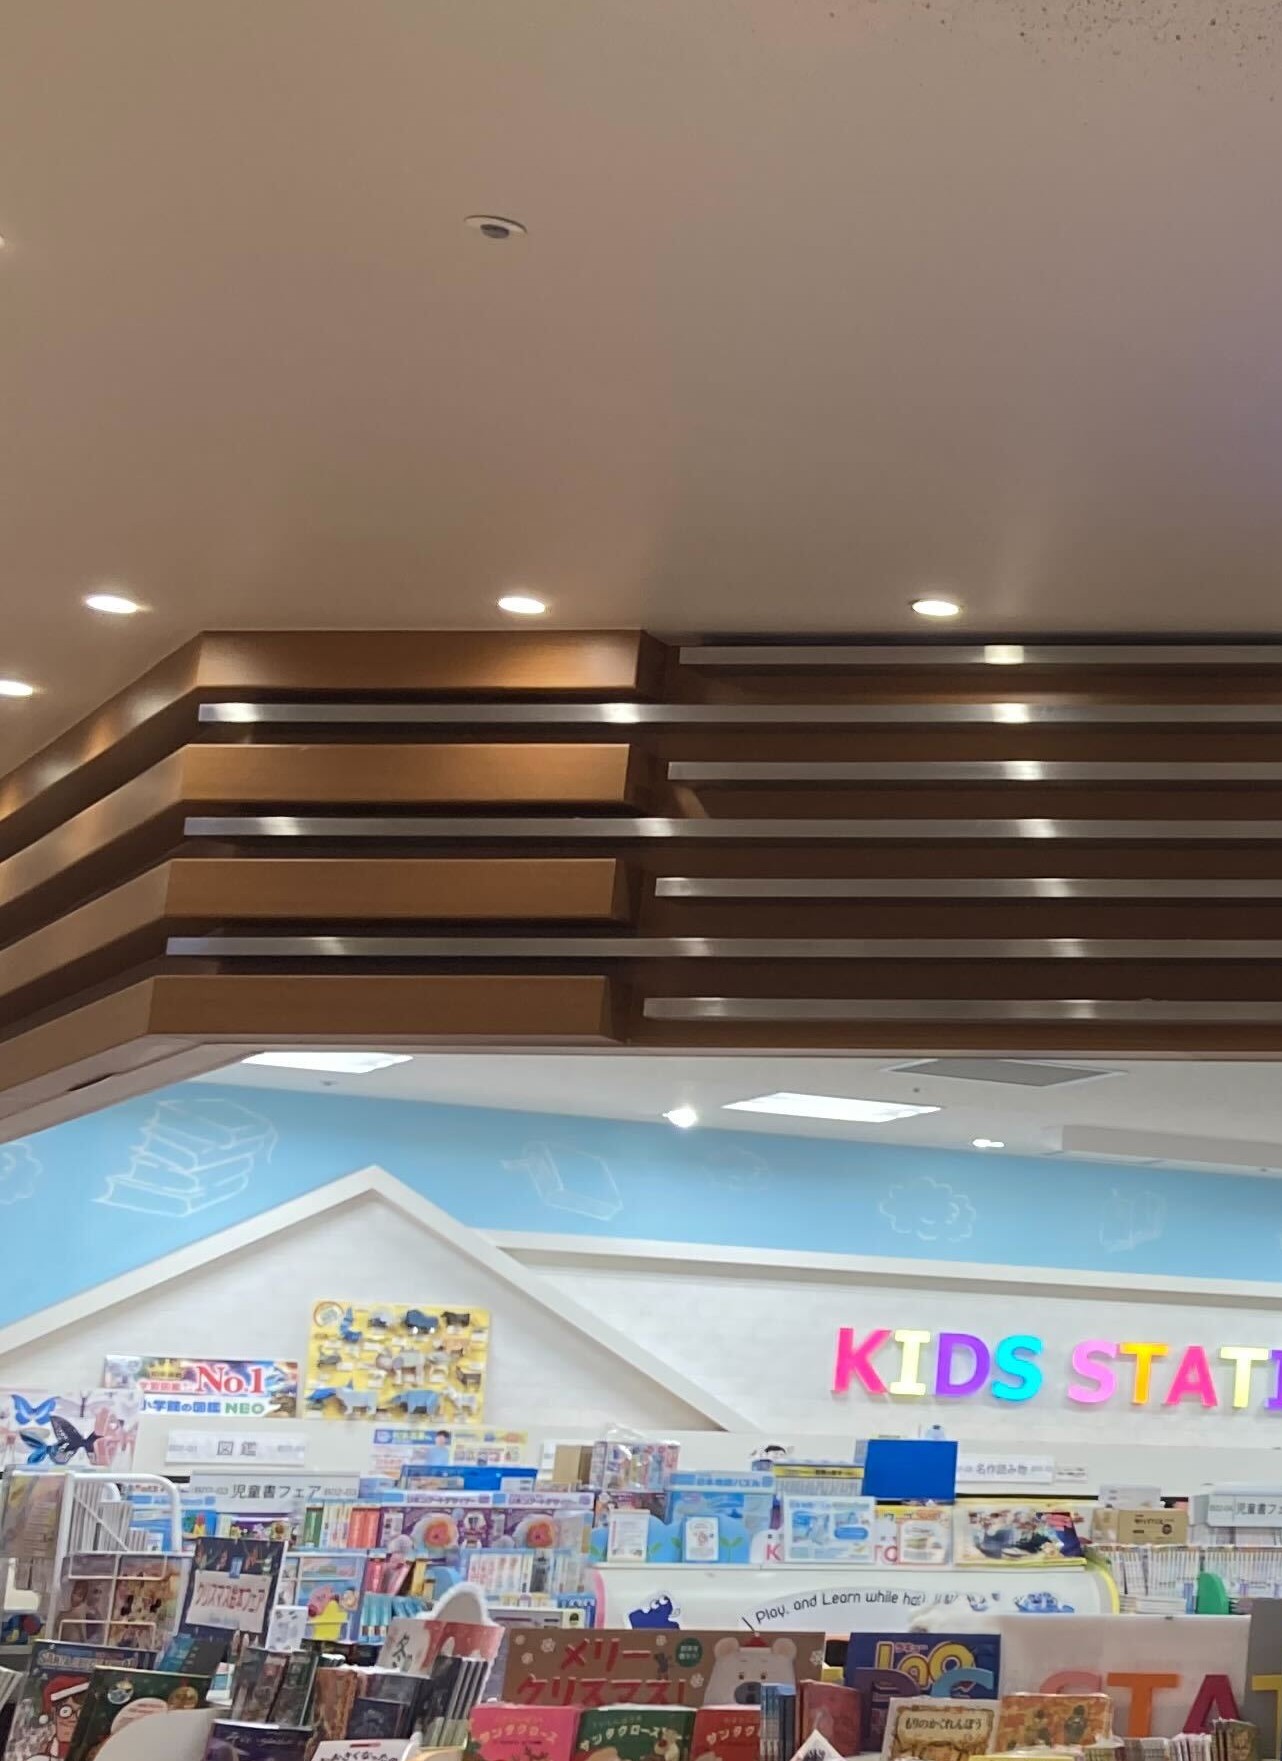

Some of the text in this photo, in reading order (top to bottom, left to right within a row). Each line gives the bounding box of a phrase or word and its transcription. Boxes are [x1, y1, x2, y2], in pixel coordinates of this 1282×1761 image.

[831, 1327, 1044, 1402] KIDS
[196, 1365, 264, 1394] No.1
[225, 1402, 265, 1415] NEO
[230, 1484, 322, 1499] 児童書フェア
[793, 1594, 817, 1612] and
[822, 1592, 861, 1606] Learn
[865, 1590, 899, 1604] while
[560, 1638, 651, 1673] メリー
